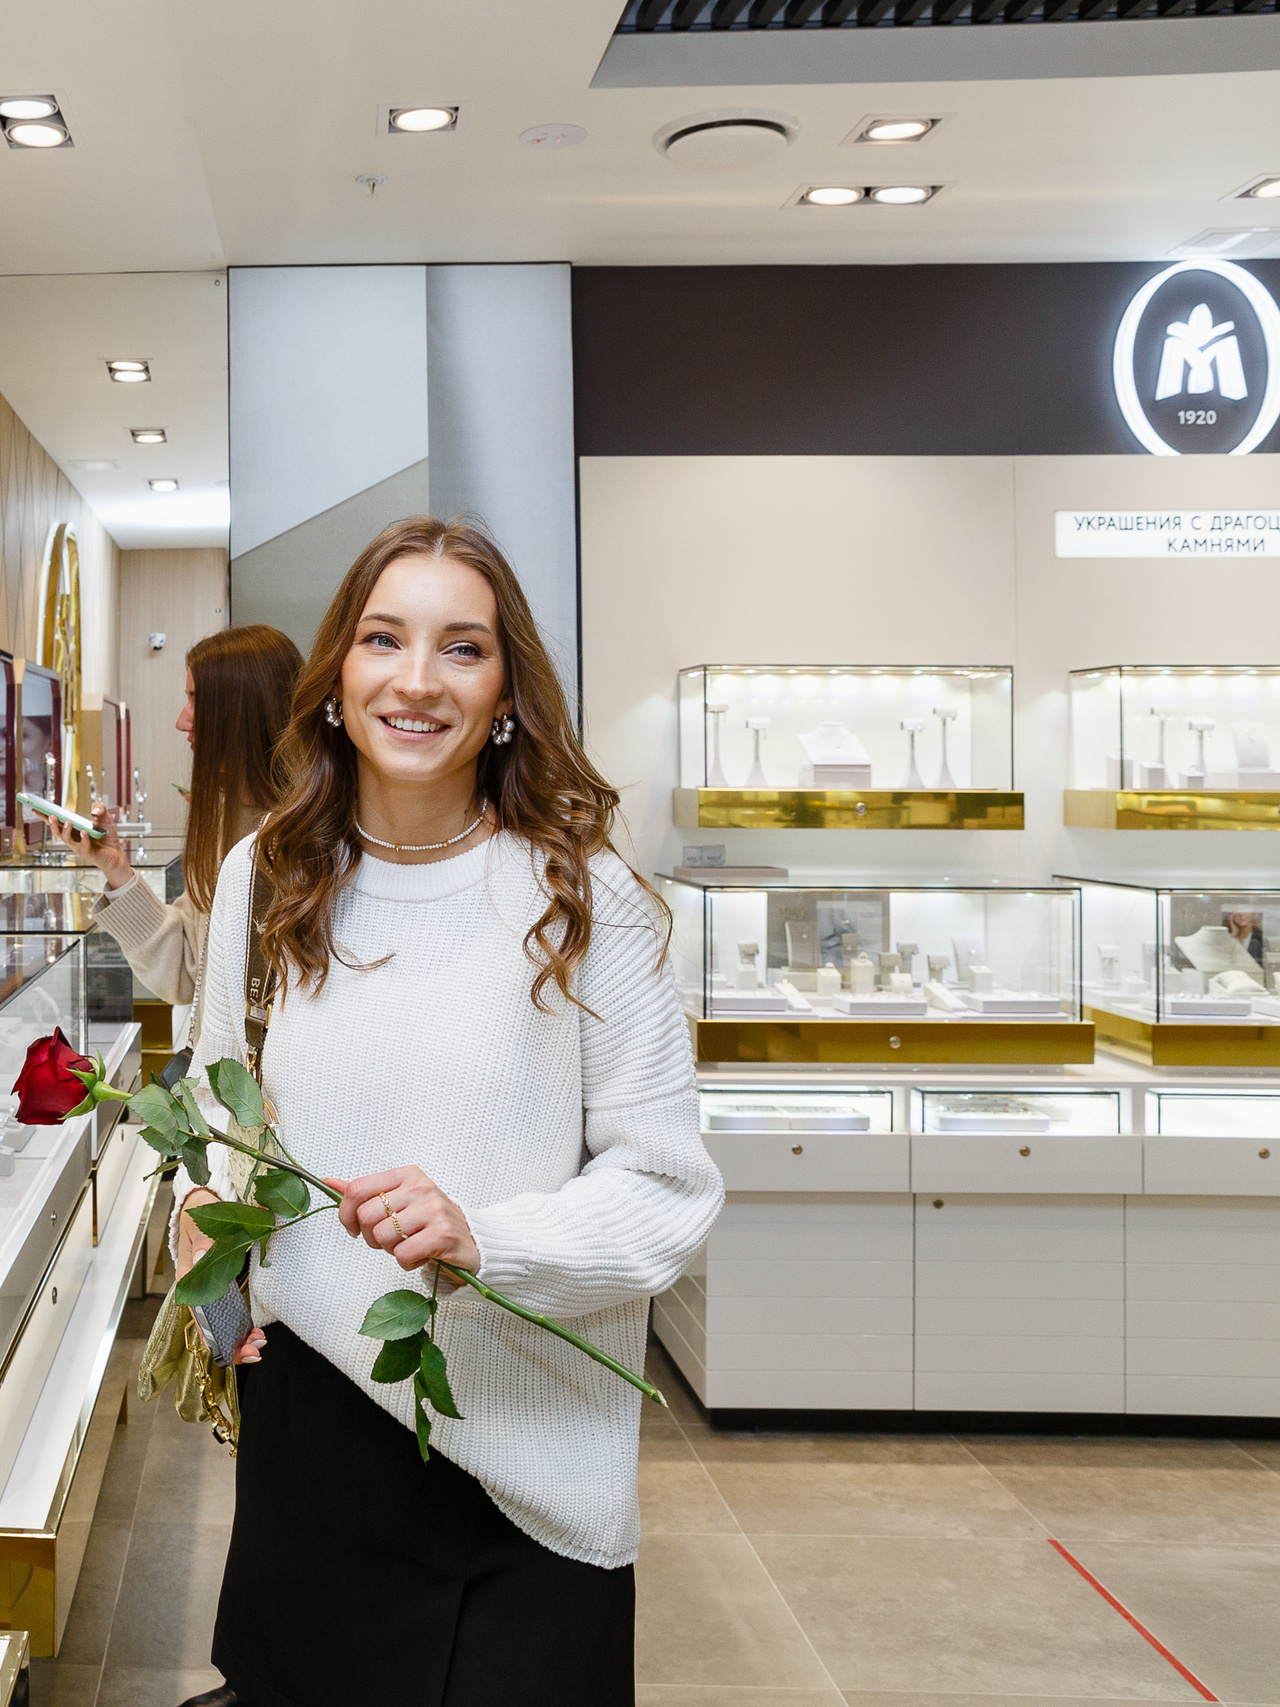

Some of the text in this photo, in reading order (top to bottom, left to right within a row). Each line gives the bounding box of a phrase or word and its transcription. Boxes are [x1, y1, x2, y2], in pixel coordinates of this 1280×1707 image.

[1177, 409, 1218, 425] 1920
[1073, 515, 1280, 533] УКРАШЕНИЯ С ДРАГОЦ
[1167, 537, 1266, 552] КАМНЯМИ
